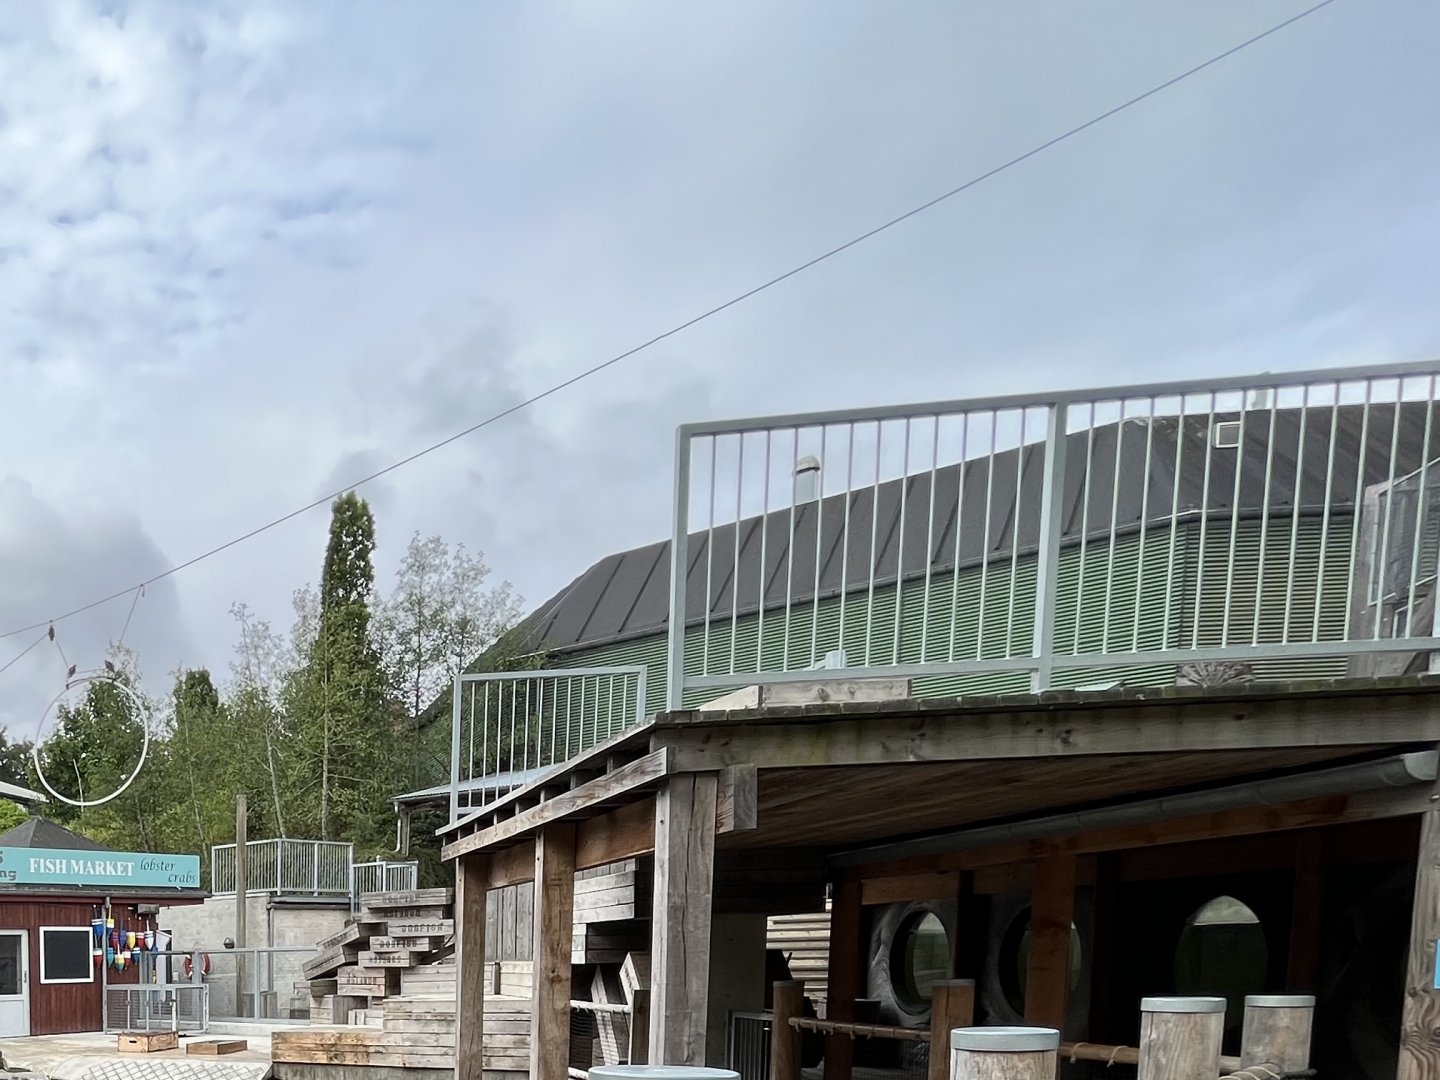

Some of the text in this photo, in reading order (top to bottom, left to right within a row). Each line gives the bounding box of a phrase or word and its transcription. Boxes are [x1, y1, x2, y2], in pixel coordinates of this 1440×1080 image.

[29, 857, 135, 877] FISH MARKET
[140, 857, 176, 872] lobster
[168, 870, 196, 883] crabs
